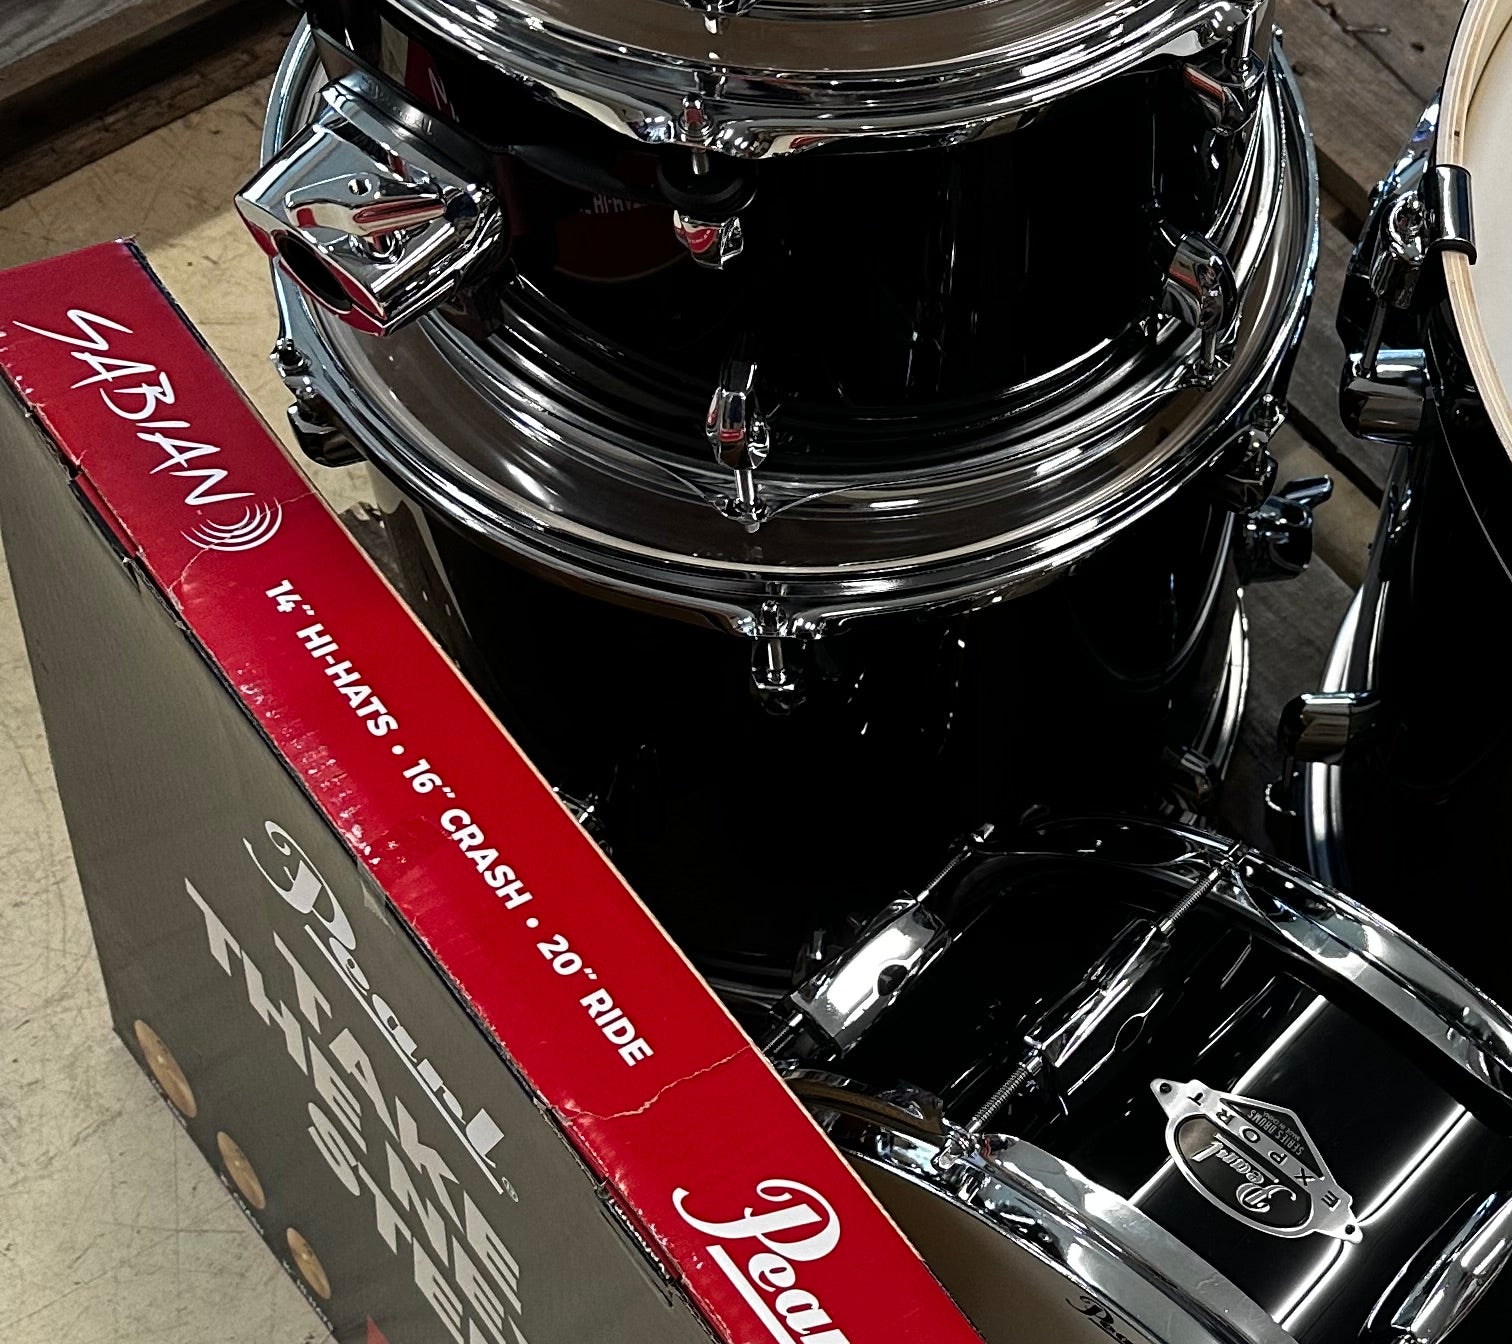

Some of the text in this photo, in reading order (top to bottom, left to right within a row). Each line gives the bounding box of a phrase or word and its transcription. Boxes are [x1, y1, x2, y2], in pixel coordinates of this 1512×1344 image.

[12, 308, 257, 506] SABIAN
[296, 623, 398, 737] HI-HATS
[440, 808, 533, 910] CRASH
[579, 987, 654, 1067] RIDE
[184, 877, 367, 1155] THE
[243, 820, 505, 1194] Pearl
[273, 930, 522, 1315] TAKE
[1187, 1092, 1341, 1211] EXPORT
[1191, 1133, 1297, 1212] Pearl
[1247, 1109, 1304, 1156] SERIES DRUMS
